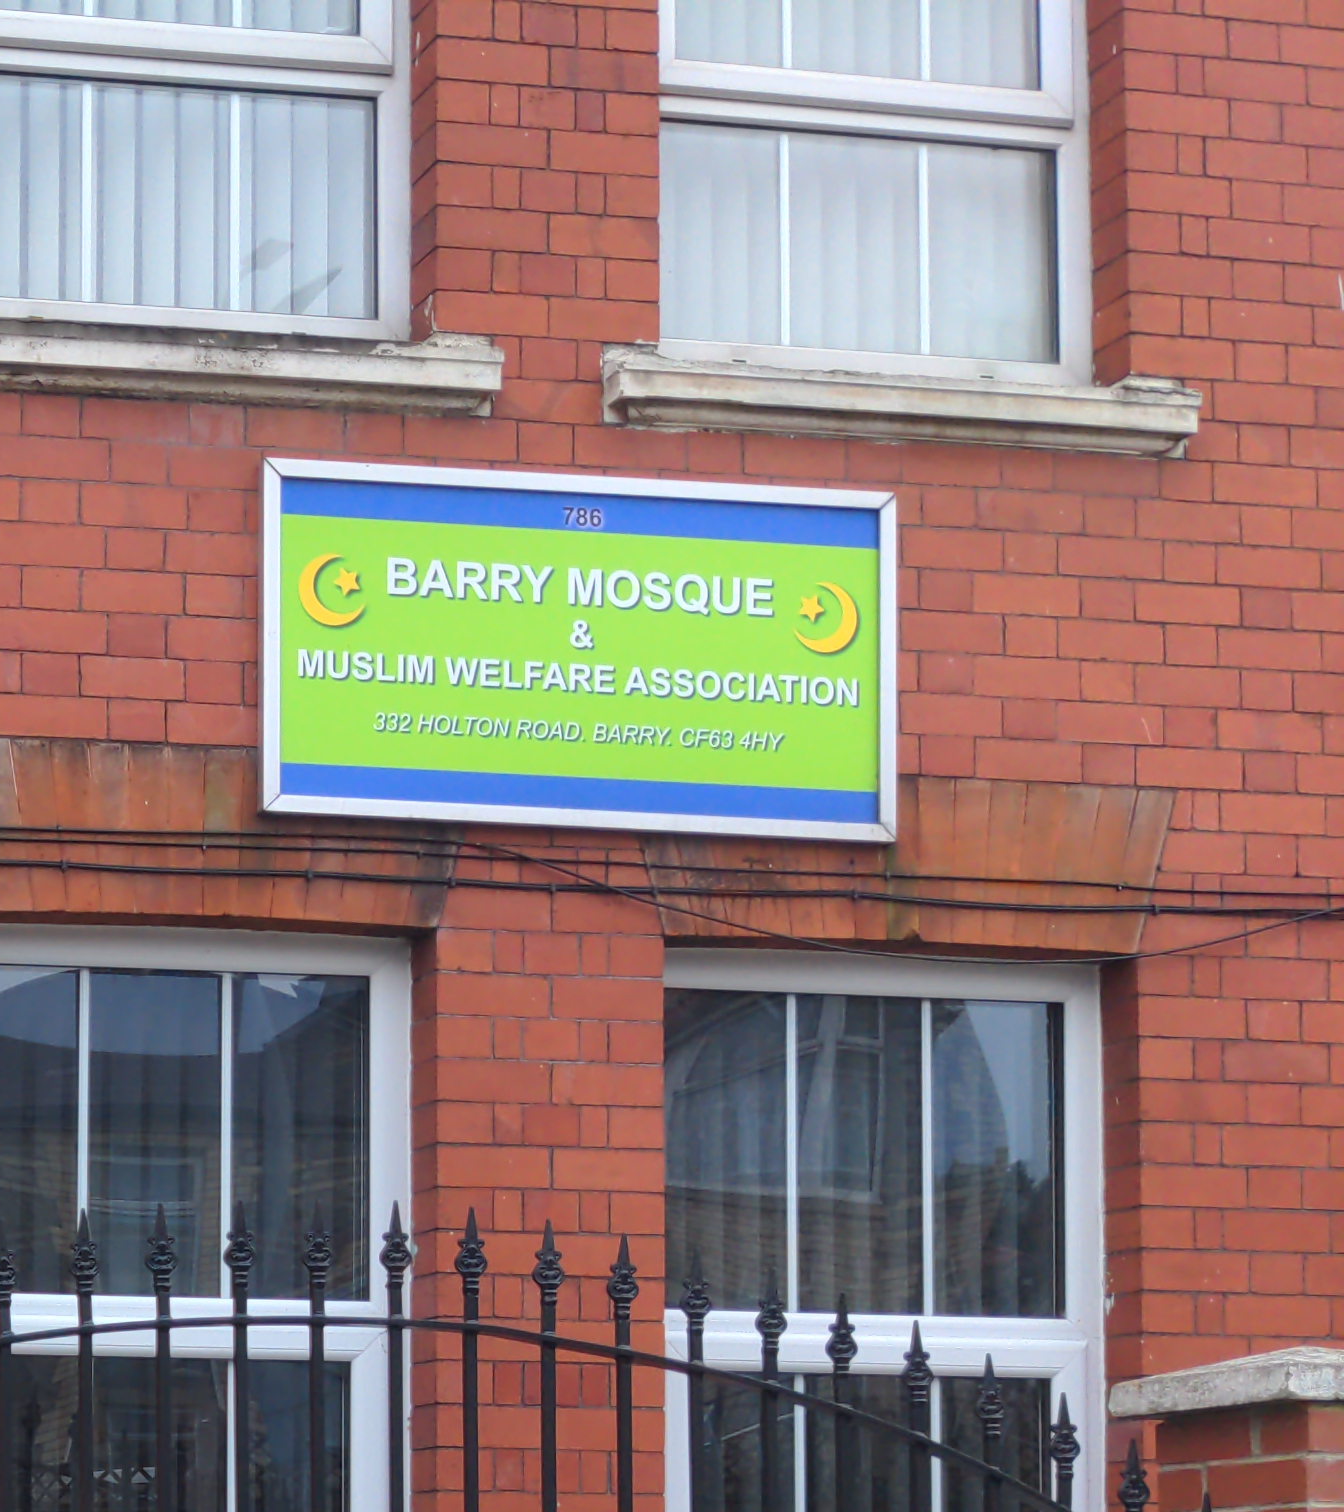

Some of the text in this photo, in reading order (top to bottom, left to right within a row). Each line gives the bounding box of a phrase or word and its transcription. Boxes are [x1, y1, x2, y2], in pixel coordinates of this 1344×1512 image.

[562, 507, 603, 528] 786
[386, 556, 774, 617] BARRY MOSQUE
[569, 619, 594, 650] &
[297, 648, 859, 707] MUSLIM WELFARE ASSOCIATION
[373, 711, 785, 752] 332 HOLTON ROAD. BARRY. CF63 4HY
